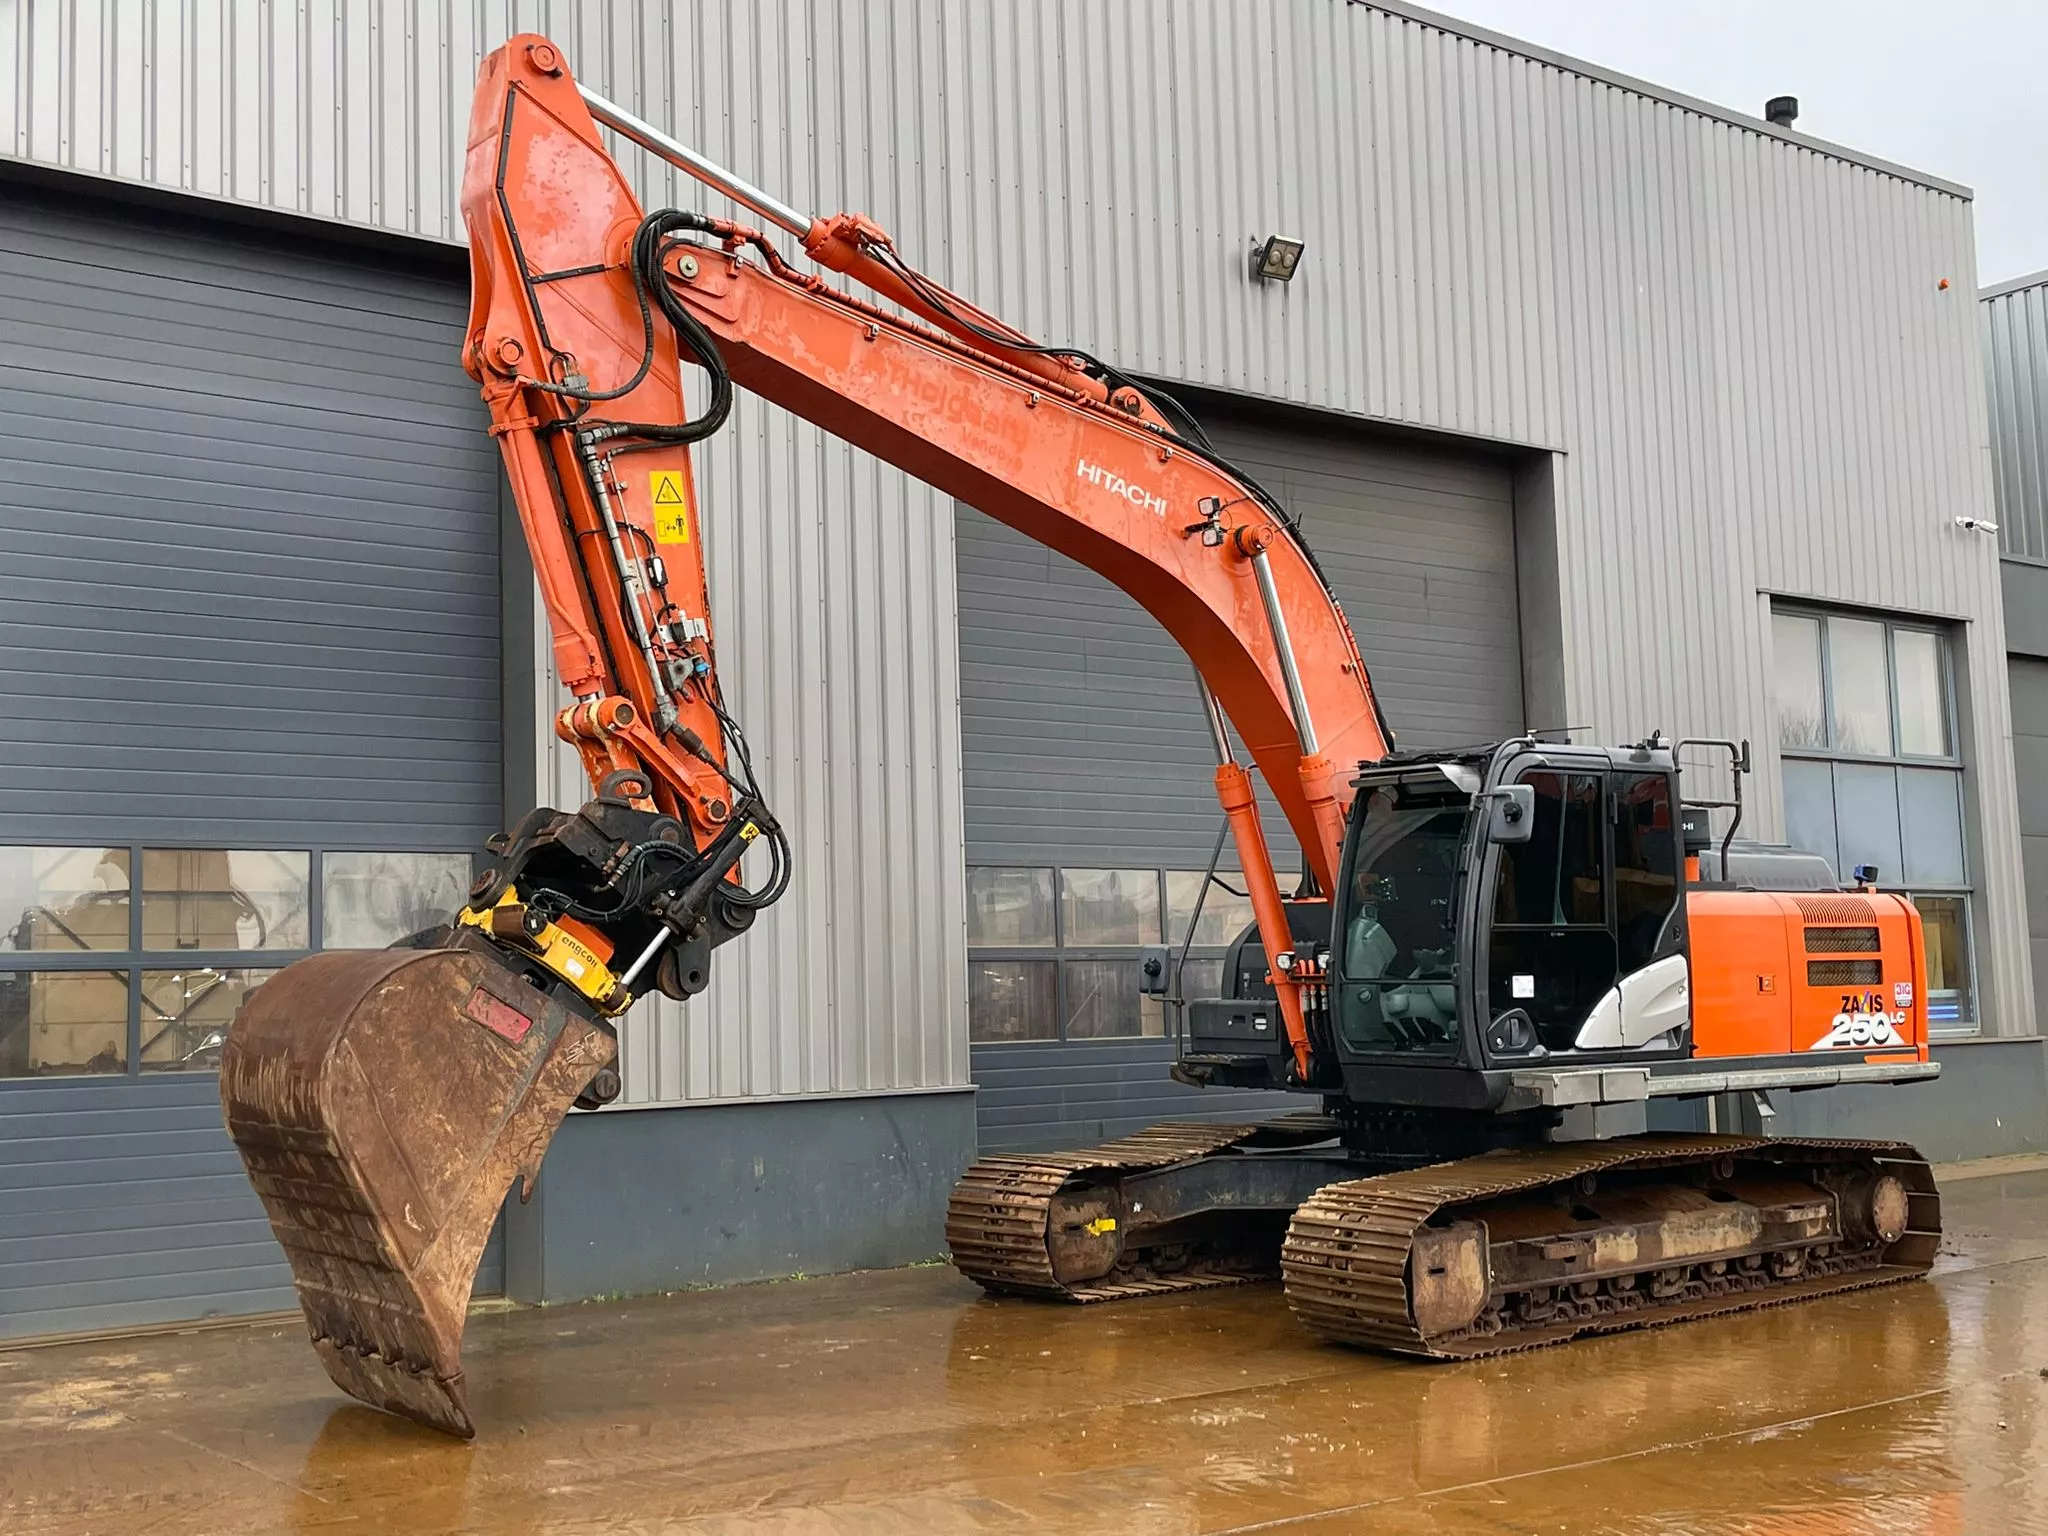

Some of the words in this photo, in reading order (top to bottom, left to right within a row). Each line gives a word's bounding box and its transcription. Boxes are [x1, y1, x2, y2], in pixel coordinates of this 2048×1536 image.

[1077, 459, 1168, 517] HITACHI
[561, 936, 598, 968] engcon
[1832, 1012, 1890, 1046] 250
[1889, 1011, 1906, 1026] LC
